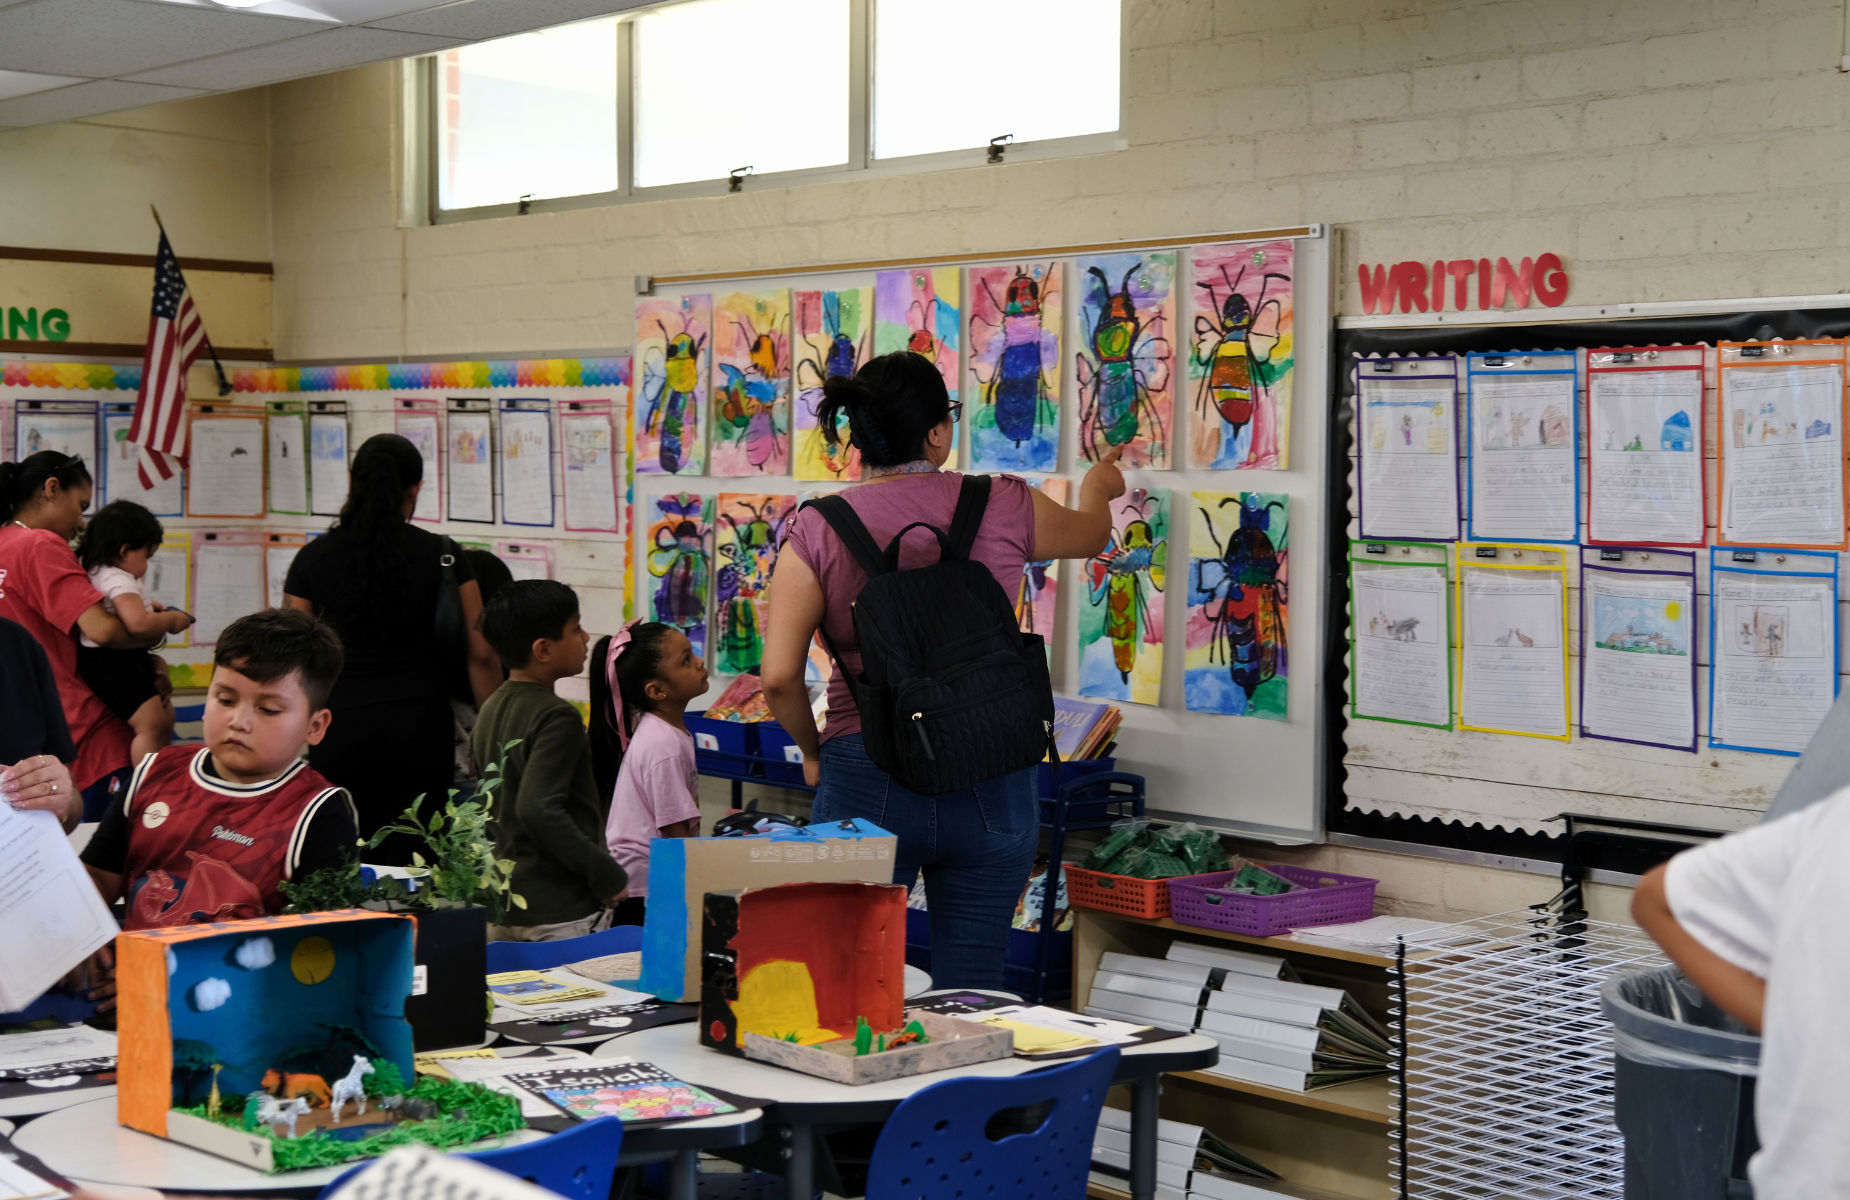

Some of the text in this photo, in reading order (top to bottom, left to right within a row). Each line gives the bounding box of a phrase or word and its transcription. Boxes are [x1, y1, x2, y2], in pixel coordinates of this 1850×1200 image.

[1358, 252, 1569, 315] WRITING
[211, 825, 255, 846] Pokémon
[522, 1068, 662, 1089] Isaiah
